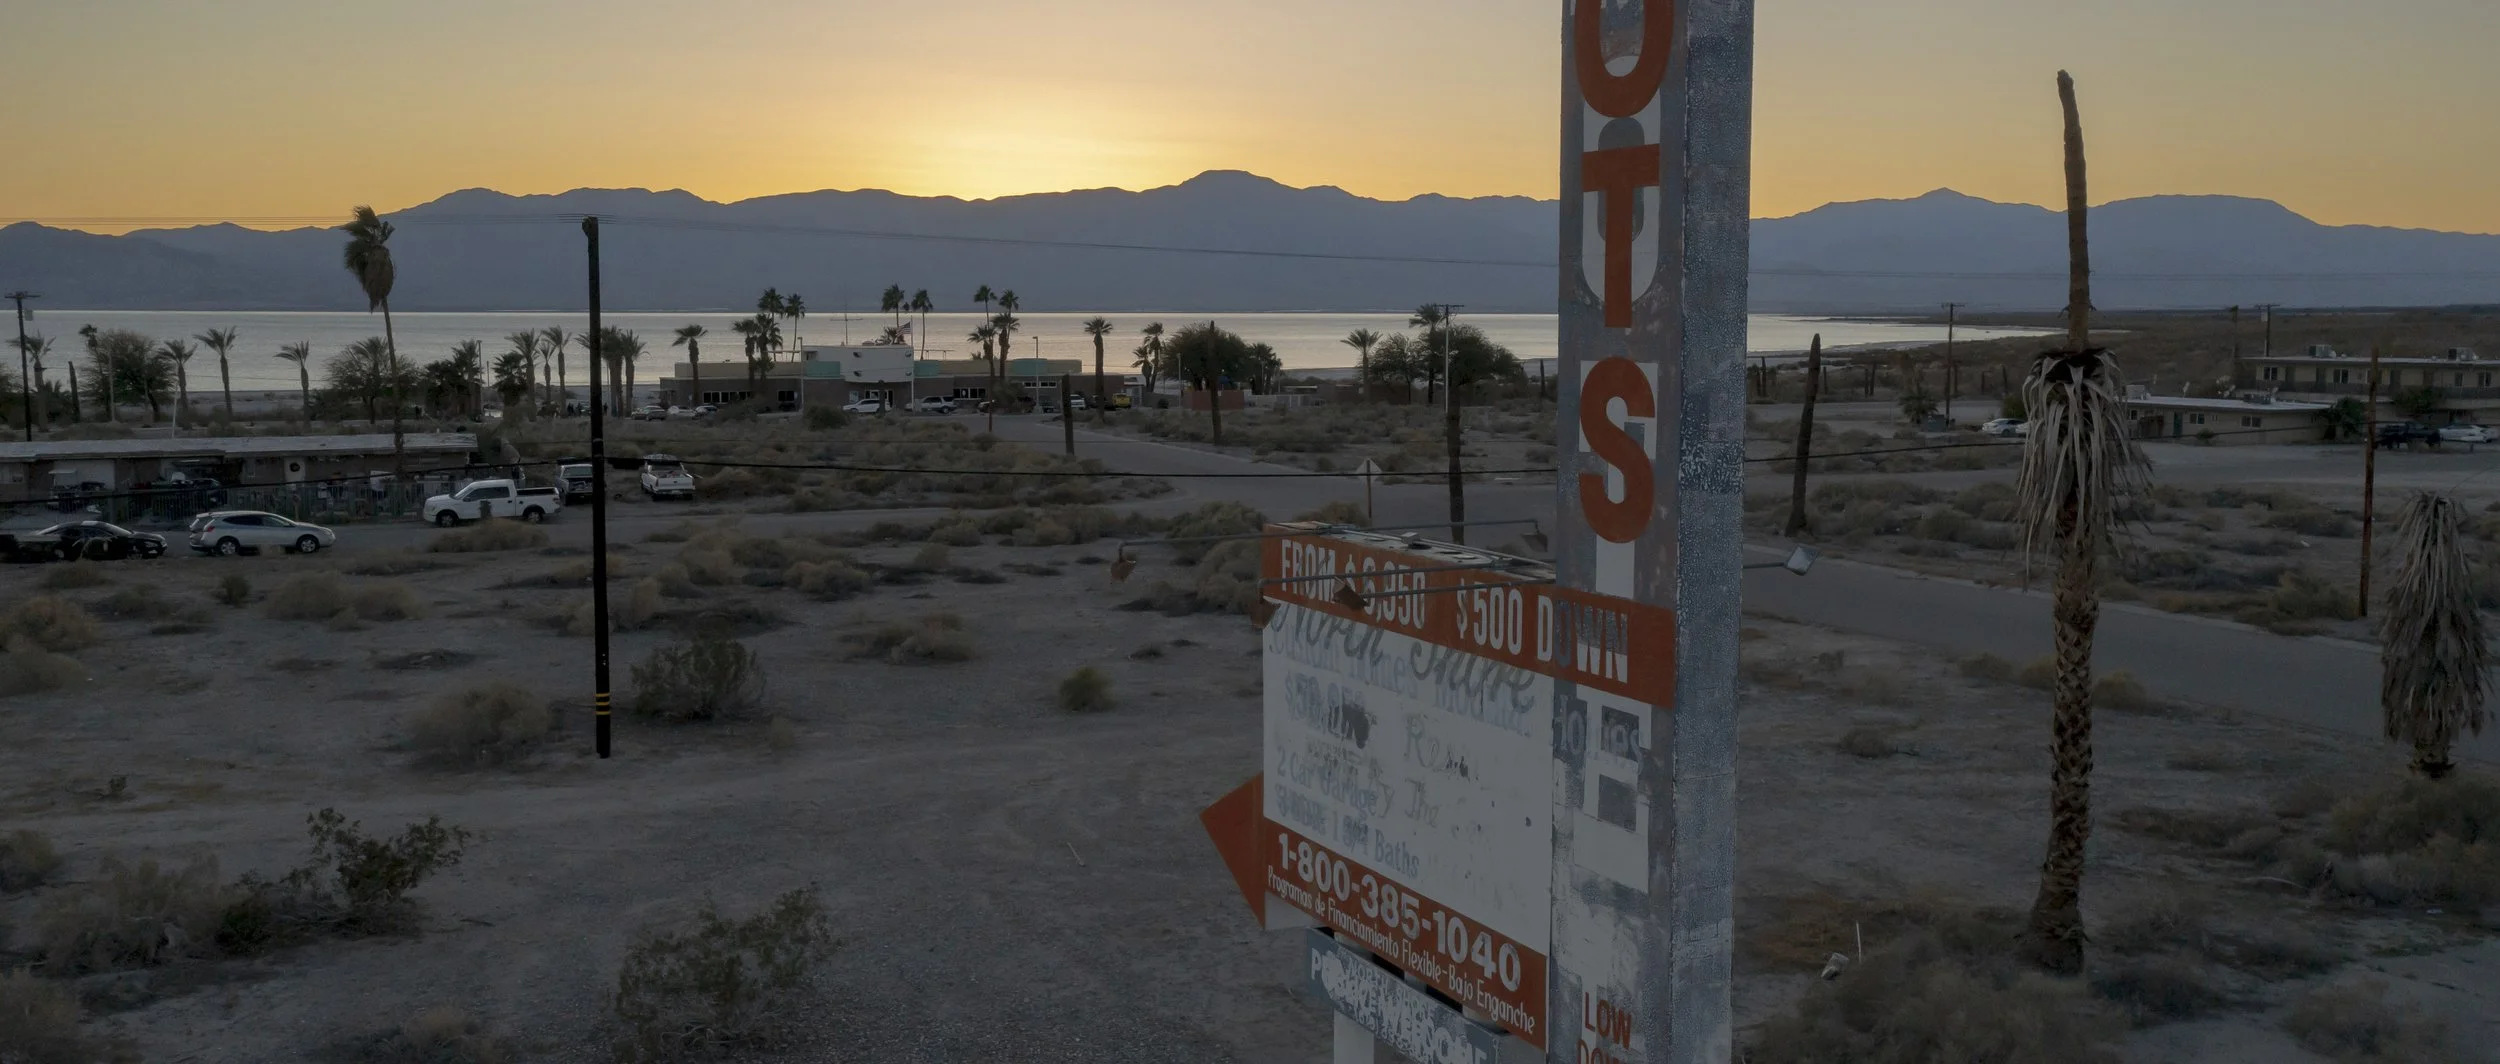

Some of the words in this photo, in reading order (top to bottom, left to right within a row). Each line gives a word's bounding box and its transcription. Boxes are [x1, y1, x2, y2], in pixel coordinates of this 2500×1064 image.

[1281, 538, 1336, 604] FROM
[1456, 577, 1524, 656] $500
[1536, 594, 1629, 684] DOWN
[1279, 832, 1521, 992] 1-800-385-1040
[1375, 828, 1421, 878] Baths
[1267, 864, 1313, 910] Programas
[1315, 892, 1326, 917] de
[1328, 896, 1399, 958] Financiamiento
[1477, 977, 1536, 1035] Enganche
[1585, 991, 1633, 1050] LOW
